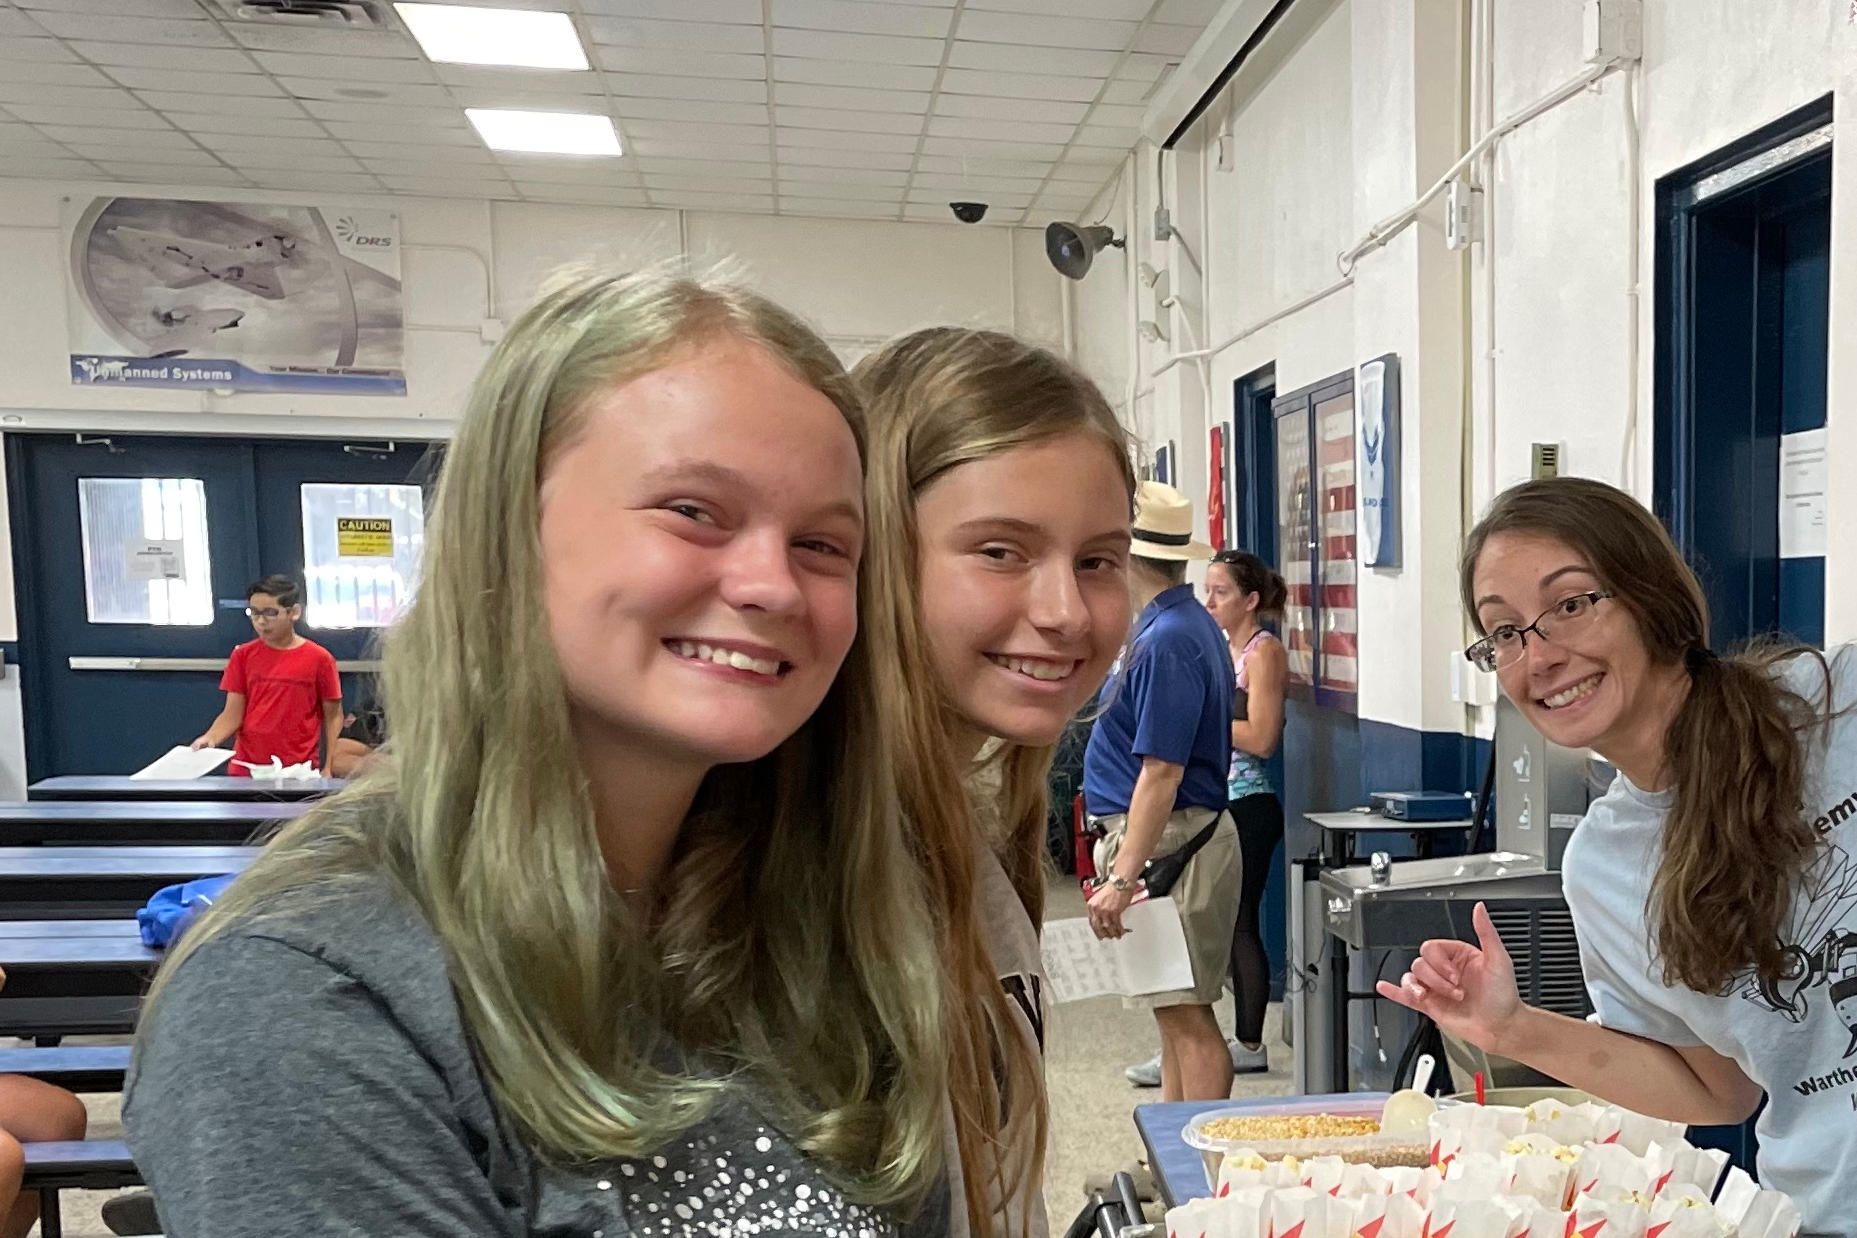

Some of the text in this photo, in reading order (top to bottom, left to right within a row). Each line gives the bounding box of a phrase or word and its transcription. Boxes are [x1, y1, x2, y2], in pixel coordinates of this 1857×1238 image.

[356, 236, 392, 247] DRS
[172, 367, 233, 382] Systems
[339, 520, 391, 531] CAUTION
